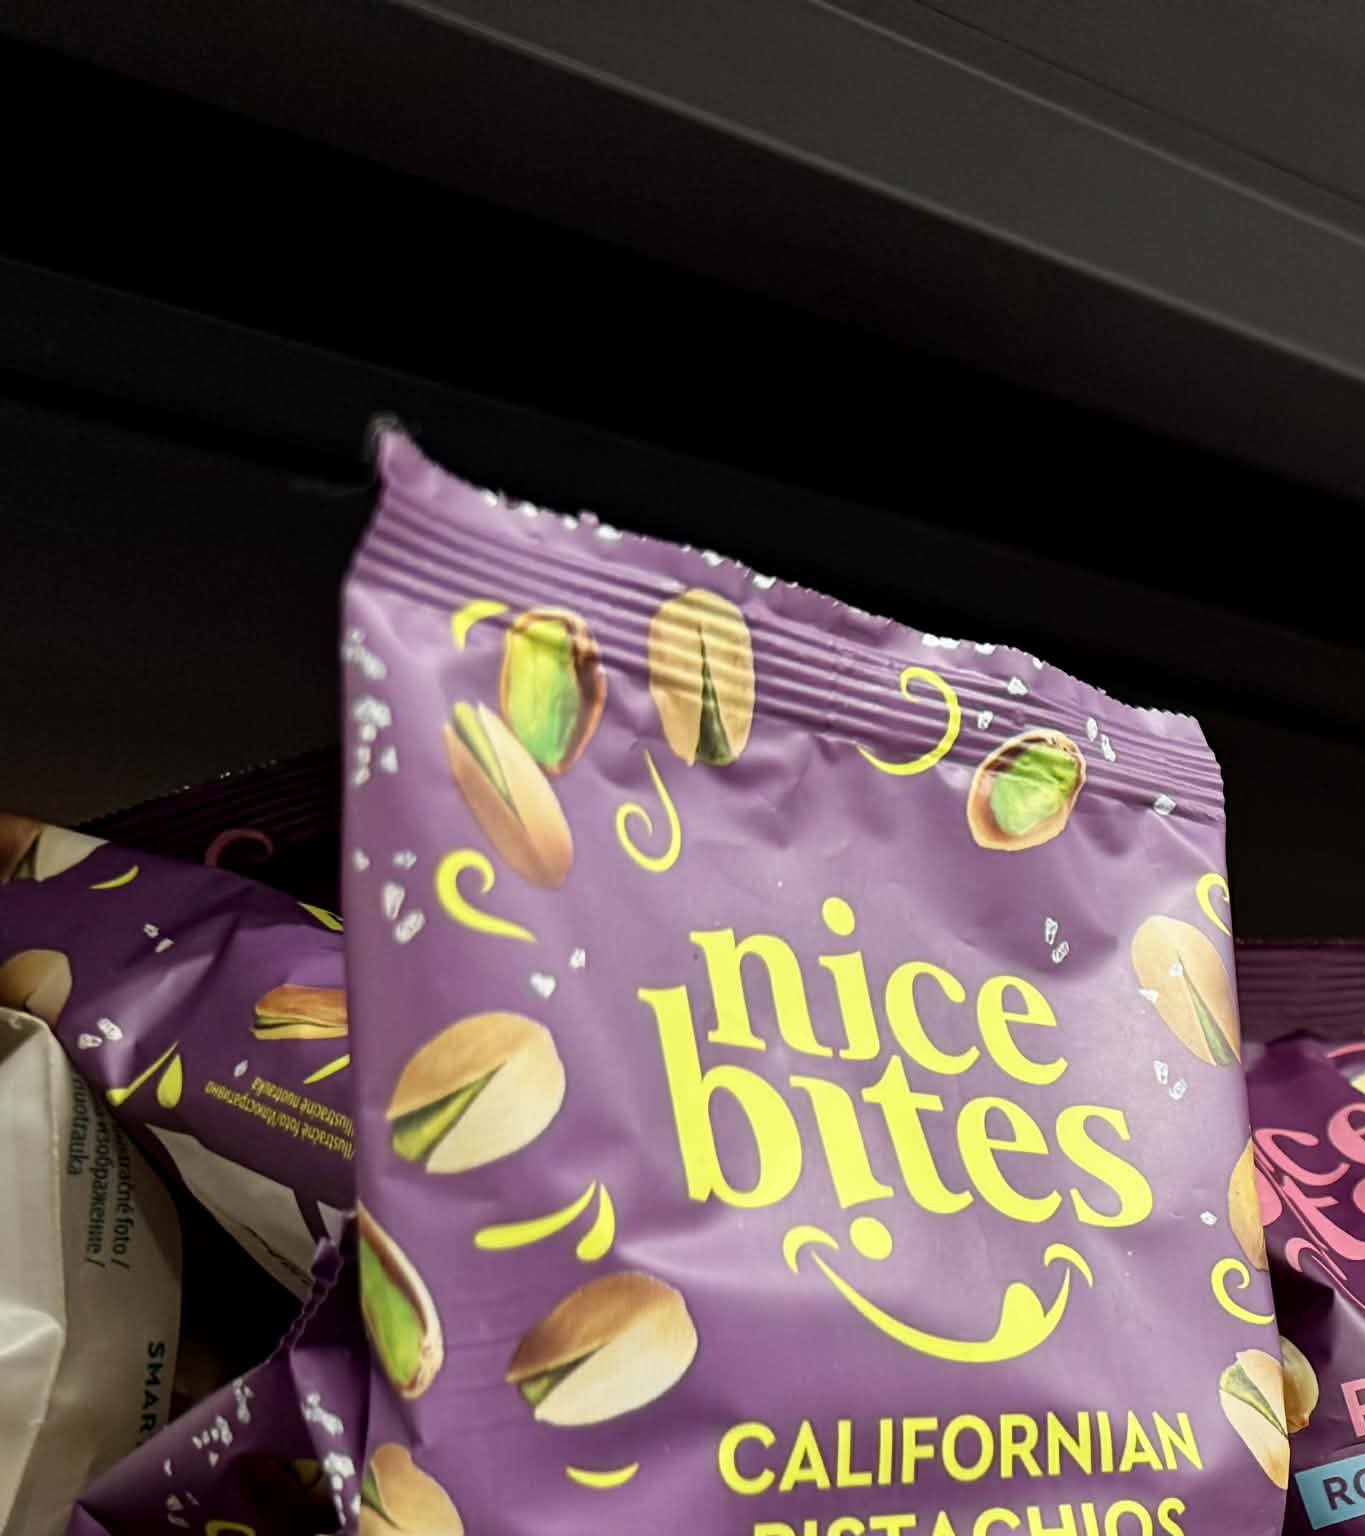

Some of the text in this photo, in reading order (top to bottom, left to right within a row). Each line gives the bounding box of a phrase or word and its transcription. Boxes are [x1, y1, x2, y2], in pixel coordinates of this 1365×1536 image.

[689, 896, 1070, 1086] nice
[638, 985, 1154, 1230] bites
[136, 1341, 166, 1447] SMAR
[718, 1410, 1203, 1496] CALIFORNIAN
